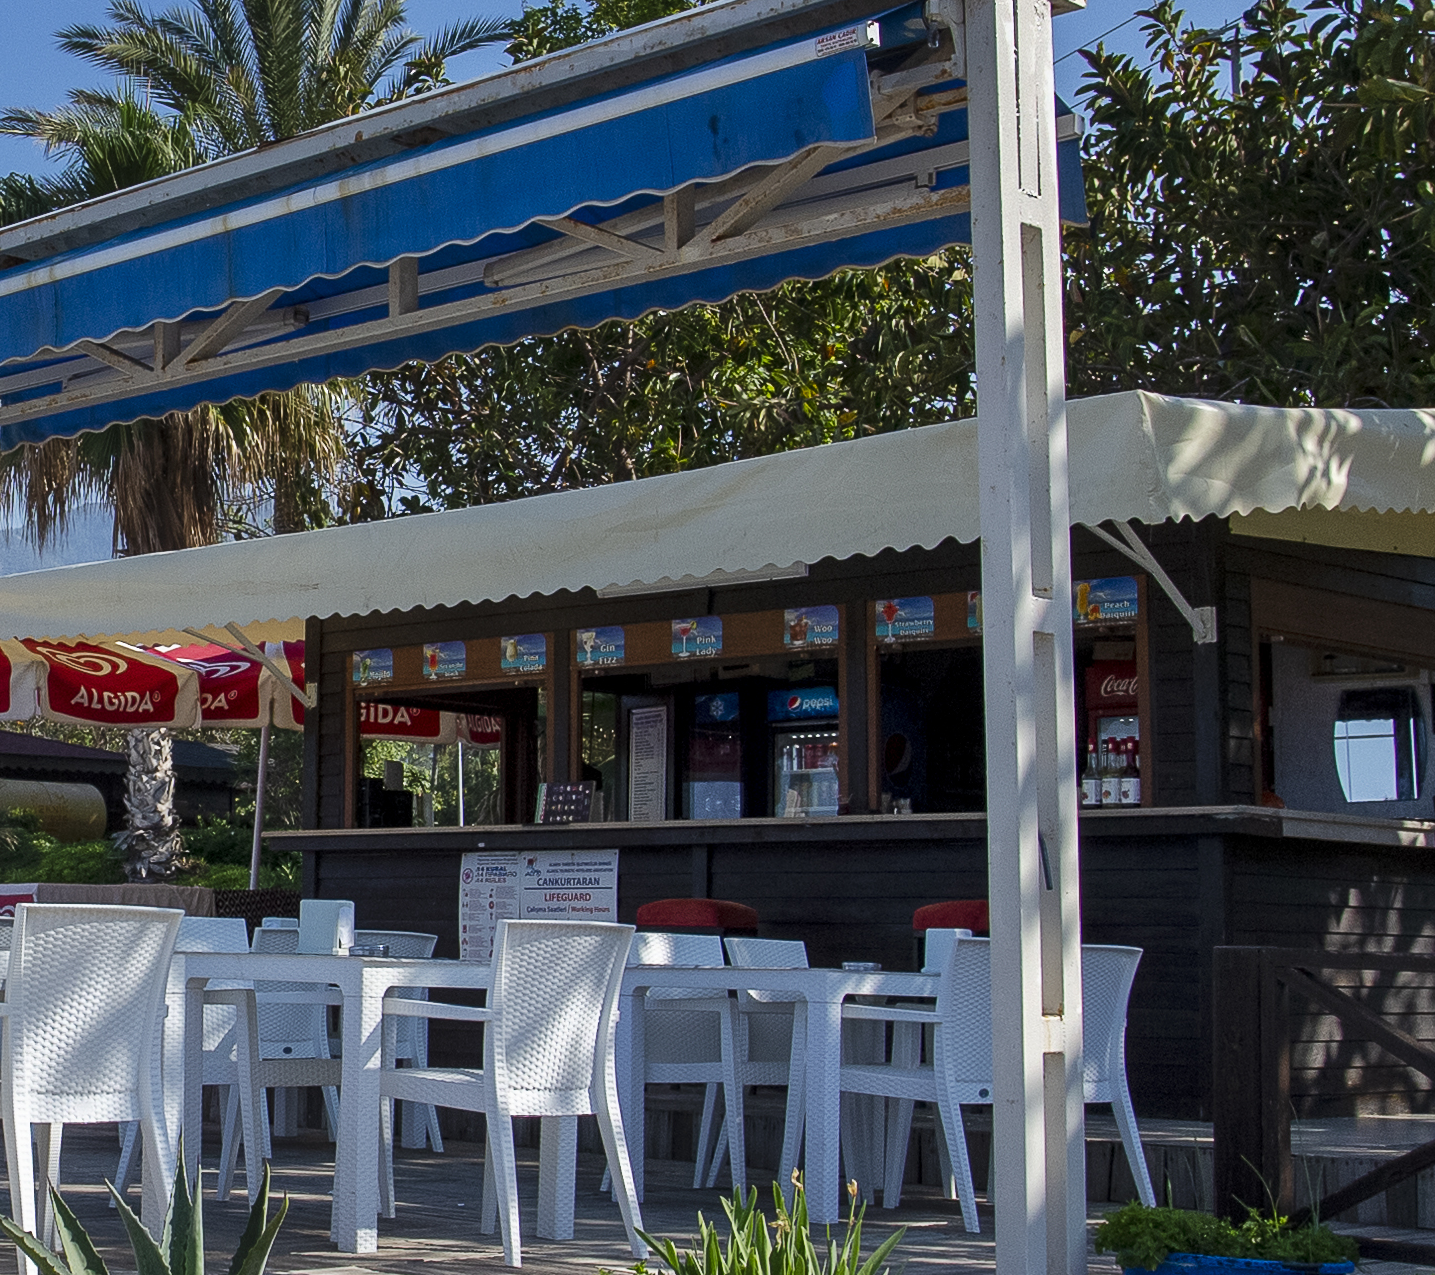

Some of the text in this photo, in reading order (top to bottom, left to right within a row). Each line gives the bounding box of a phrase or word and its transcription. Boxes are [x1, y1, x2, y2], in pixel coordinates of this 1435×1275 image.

[1104, 601, 1130, 609] Peach
[814, 625, 832, 633] Woo
[696, 635, 716, 644] Pink
[814, 636, 832, 644] Woo
[600, 643, 615, 652] Gin
[696, 646, 716, 656] Lady
[599, 656, 617, 664] Fizz
[802, 695, 834, 710] pepsi
[536, 877, 600, 886] CANKURTARAN
[544, 893, 592, 902] LIFEGUARD
[571, 905, 593, 914] Working
